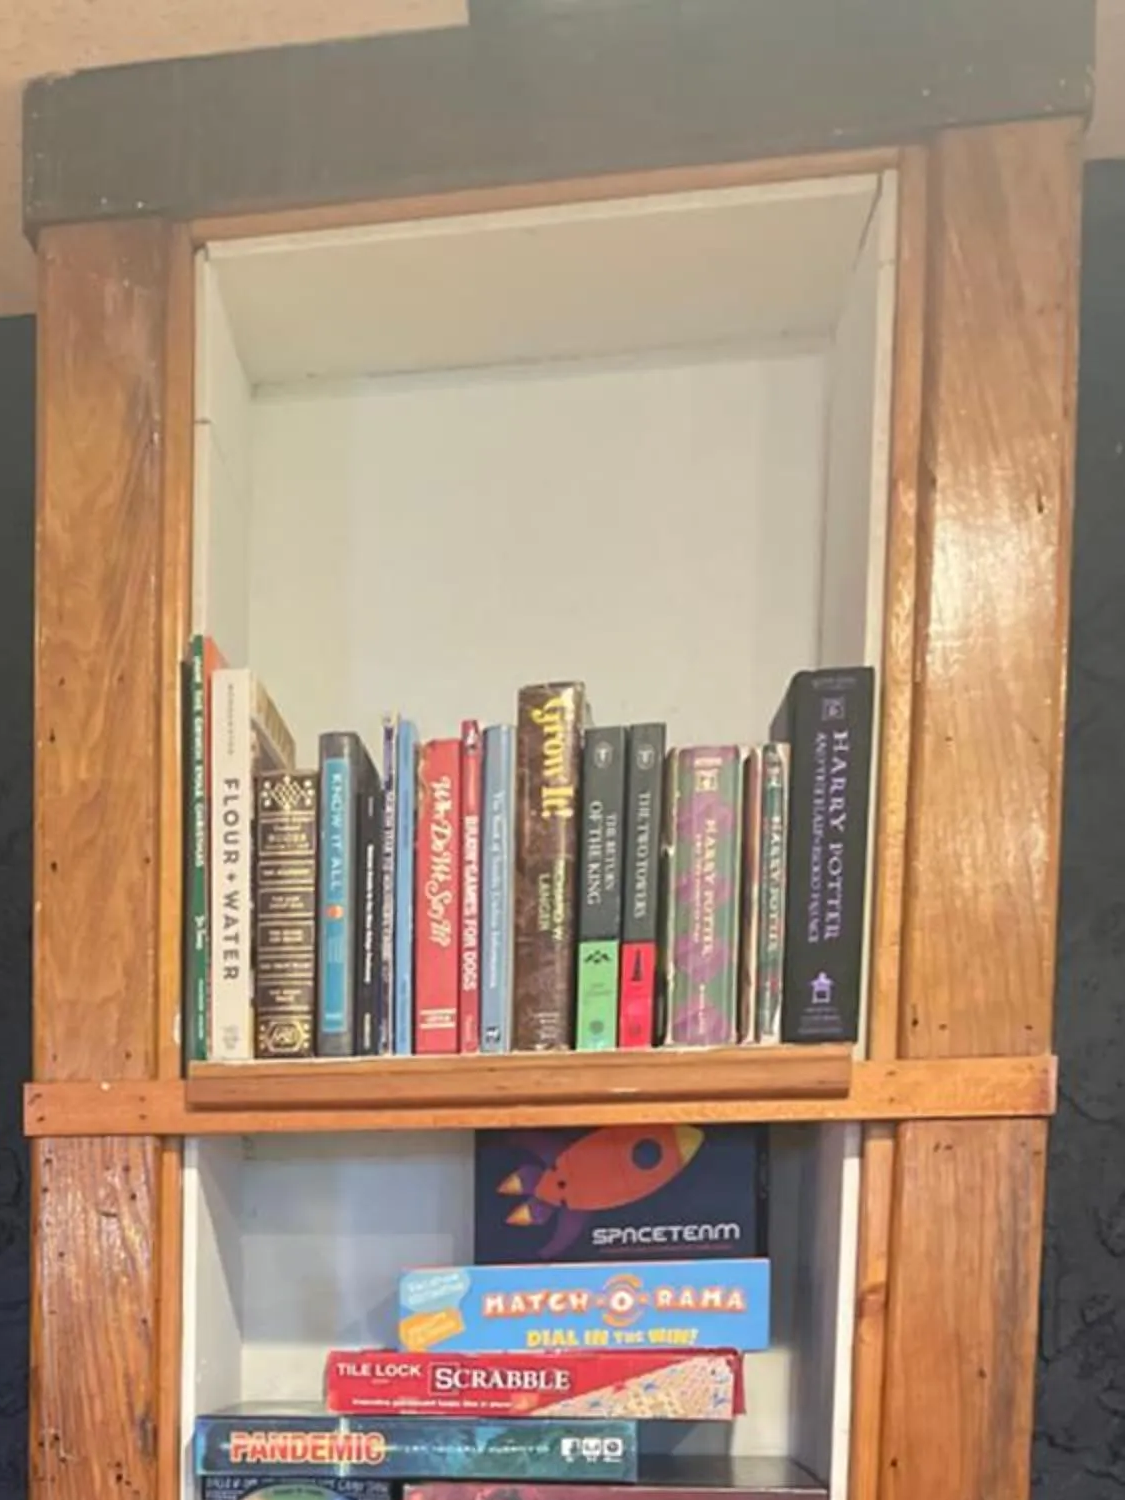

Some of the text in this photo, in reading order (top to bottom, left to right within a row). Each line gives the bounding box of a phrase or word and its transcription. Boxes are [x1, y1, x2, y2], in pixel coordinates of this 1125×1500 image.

[531, 696, 573, 820] Grow It!
[223, 778, 240, 863] FLOUR
[330, 773, 344, 892] KNOW IT ALL
[430, 822, 455, 850] Do
[823, 728, 850, 941] HARRY POTTER
[431, 850, 455, 880] We
[586, 800, 603, 906] OF THE KING
[604, 840, 616, 890] RETURN
[632, 791, 651, 918] THE TWO TOWERS
[426, 880, 453, 916] Say
[464, 864, 479, 915] GAMES
[538, 873, 551, 932] LANGER
[701, 818, 717, 957] HARRY POTTER
[767, 816, 781, 955] HARRY POTTER
[223, 891, 240, 982] WATER
[464, 919, 479, 948] FOR
[808, 892, 821, 943] PRINCE
[464, 951, 479, 991] DOGS
[592, 1223, 741, 1246] SPACETEAM
[526, 1329, 578, 1347] DIAL
[583, 1329, 609, 1346] IN
[614, 1331, 644, 1344] THE
[337, 1363, 421, 1377] TILE LOCK
[434, 1368, 571, 1391] SCRABBLE
[229, 1431, 386, 1465] PANDEMIC
